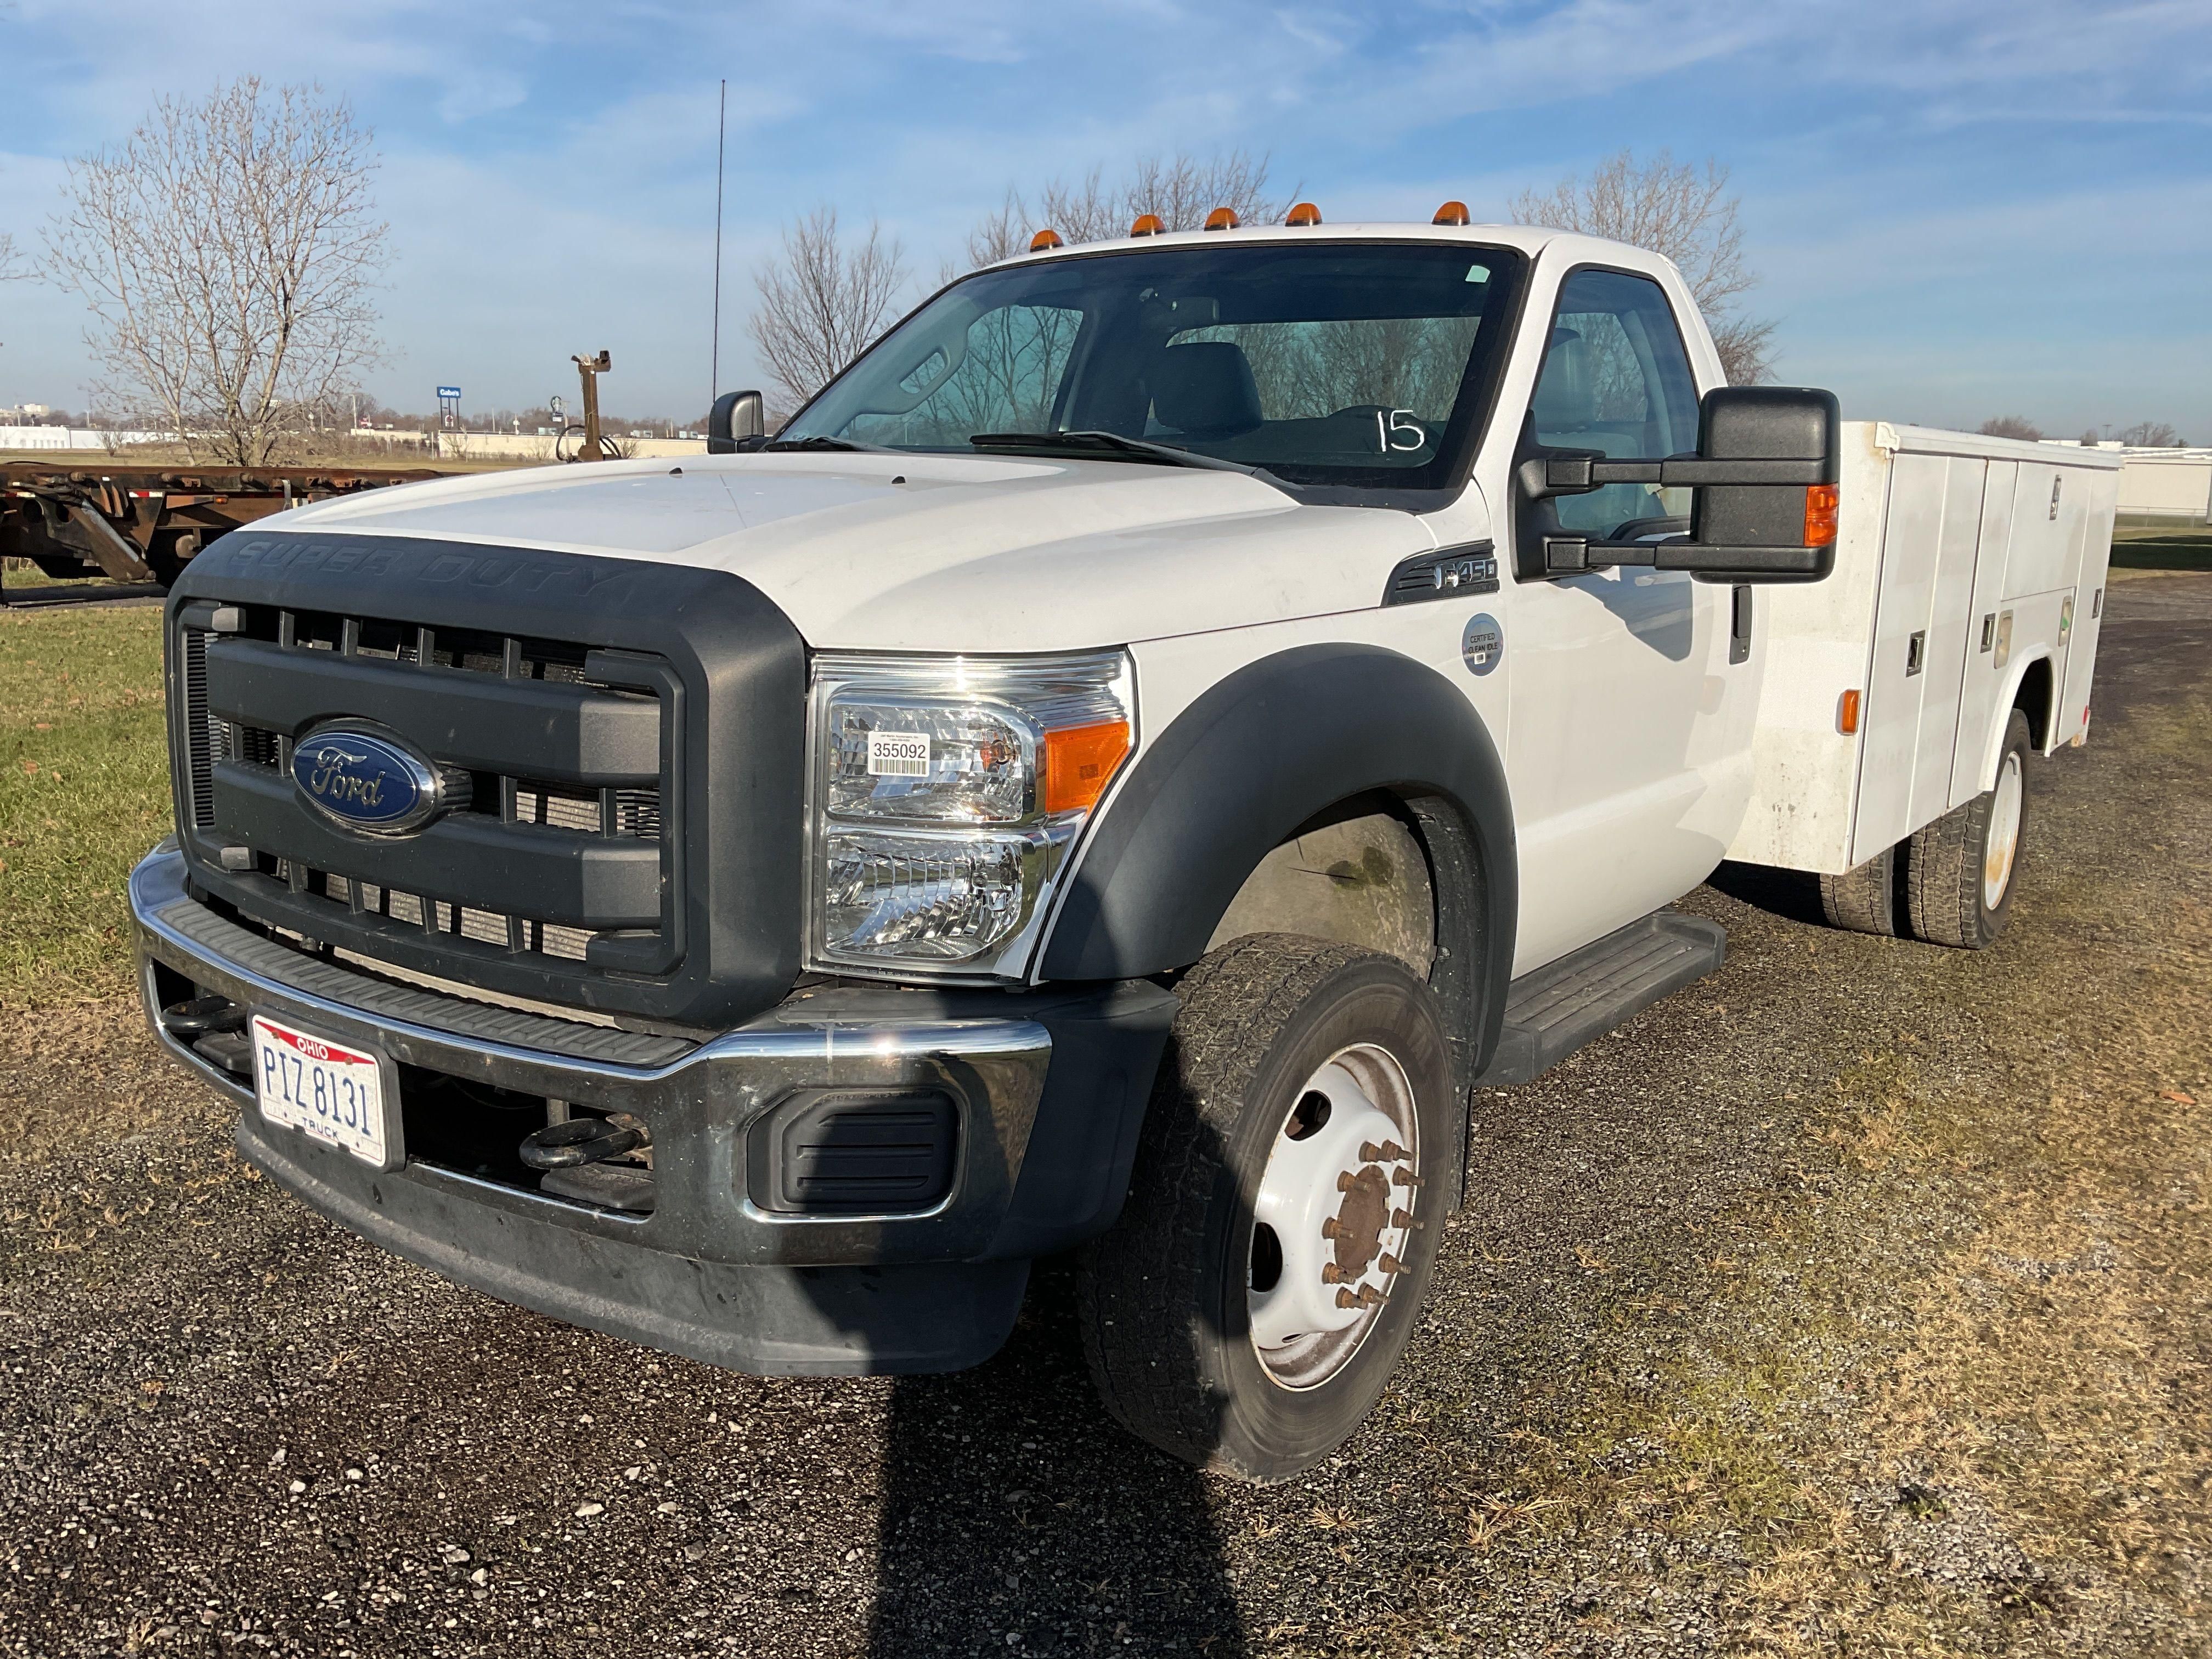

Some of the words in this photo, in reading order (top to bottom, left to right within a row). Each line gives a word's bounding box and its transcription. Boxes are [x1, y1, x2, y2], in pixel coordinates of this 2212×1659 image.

[1378, 410, 1425, 452] 15
[229, 540, 404, 575] SUPER
[417, 554, 636, 597] DUTY
[1468, 643, 1486, 654] CLEAN
[1486, 642, 1498, 651] IDLE
[1470, 633, 1496, 644] CERTIFIED
[874, 743, 926, 759] 355092
[311, 746, 386, 806] Ford
[297, 1037, 328, 1060] OHIO
[263, 1045, 307, 1108] PIZ
[313, 1066, 371, 1136] 8131
[302, 1117, 339, 1139] TRUCK
